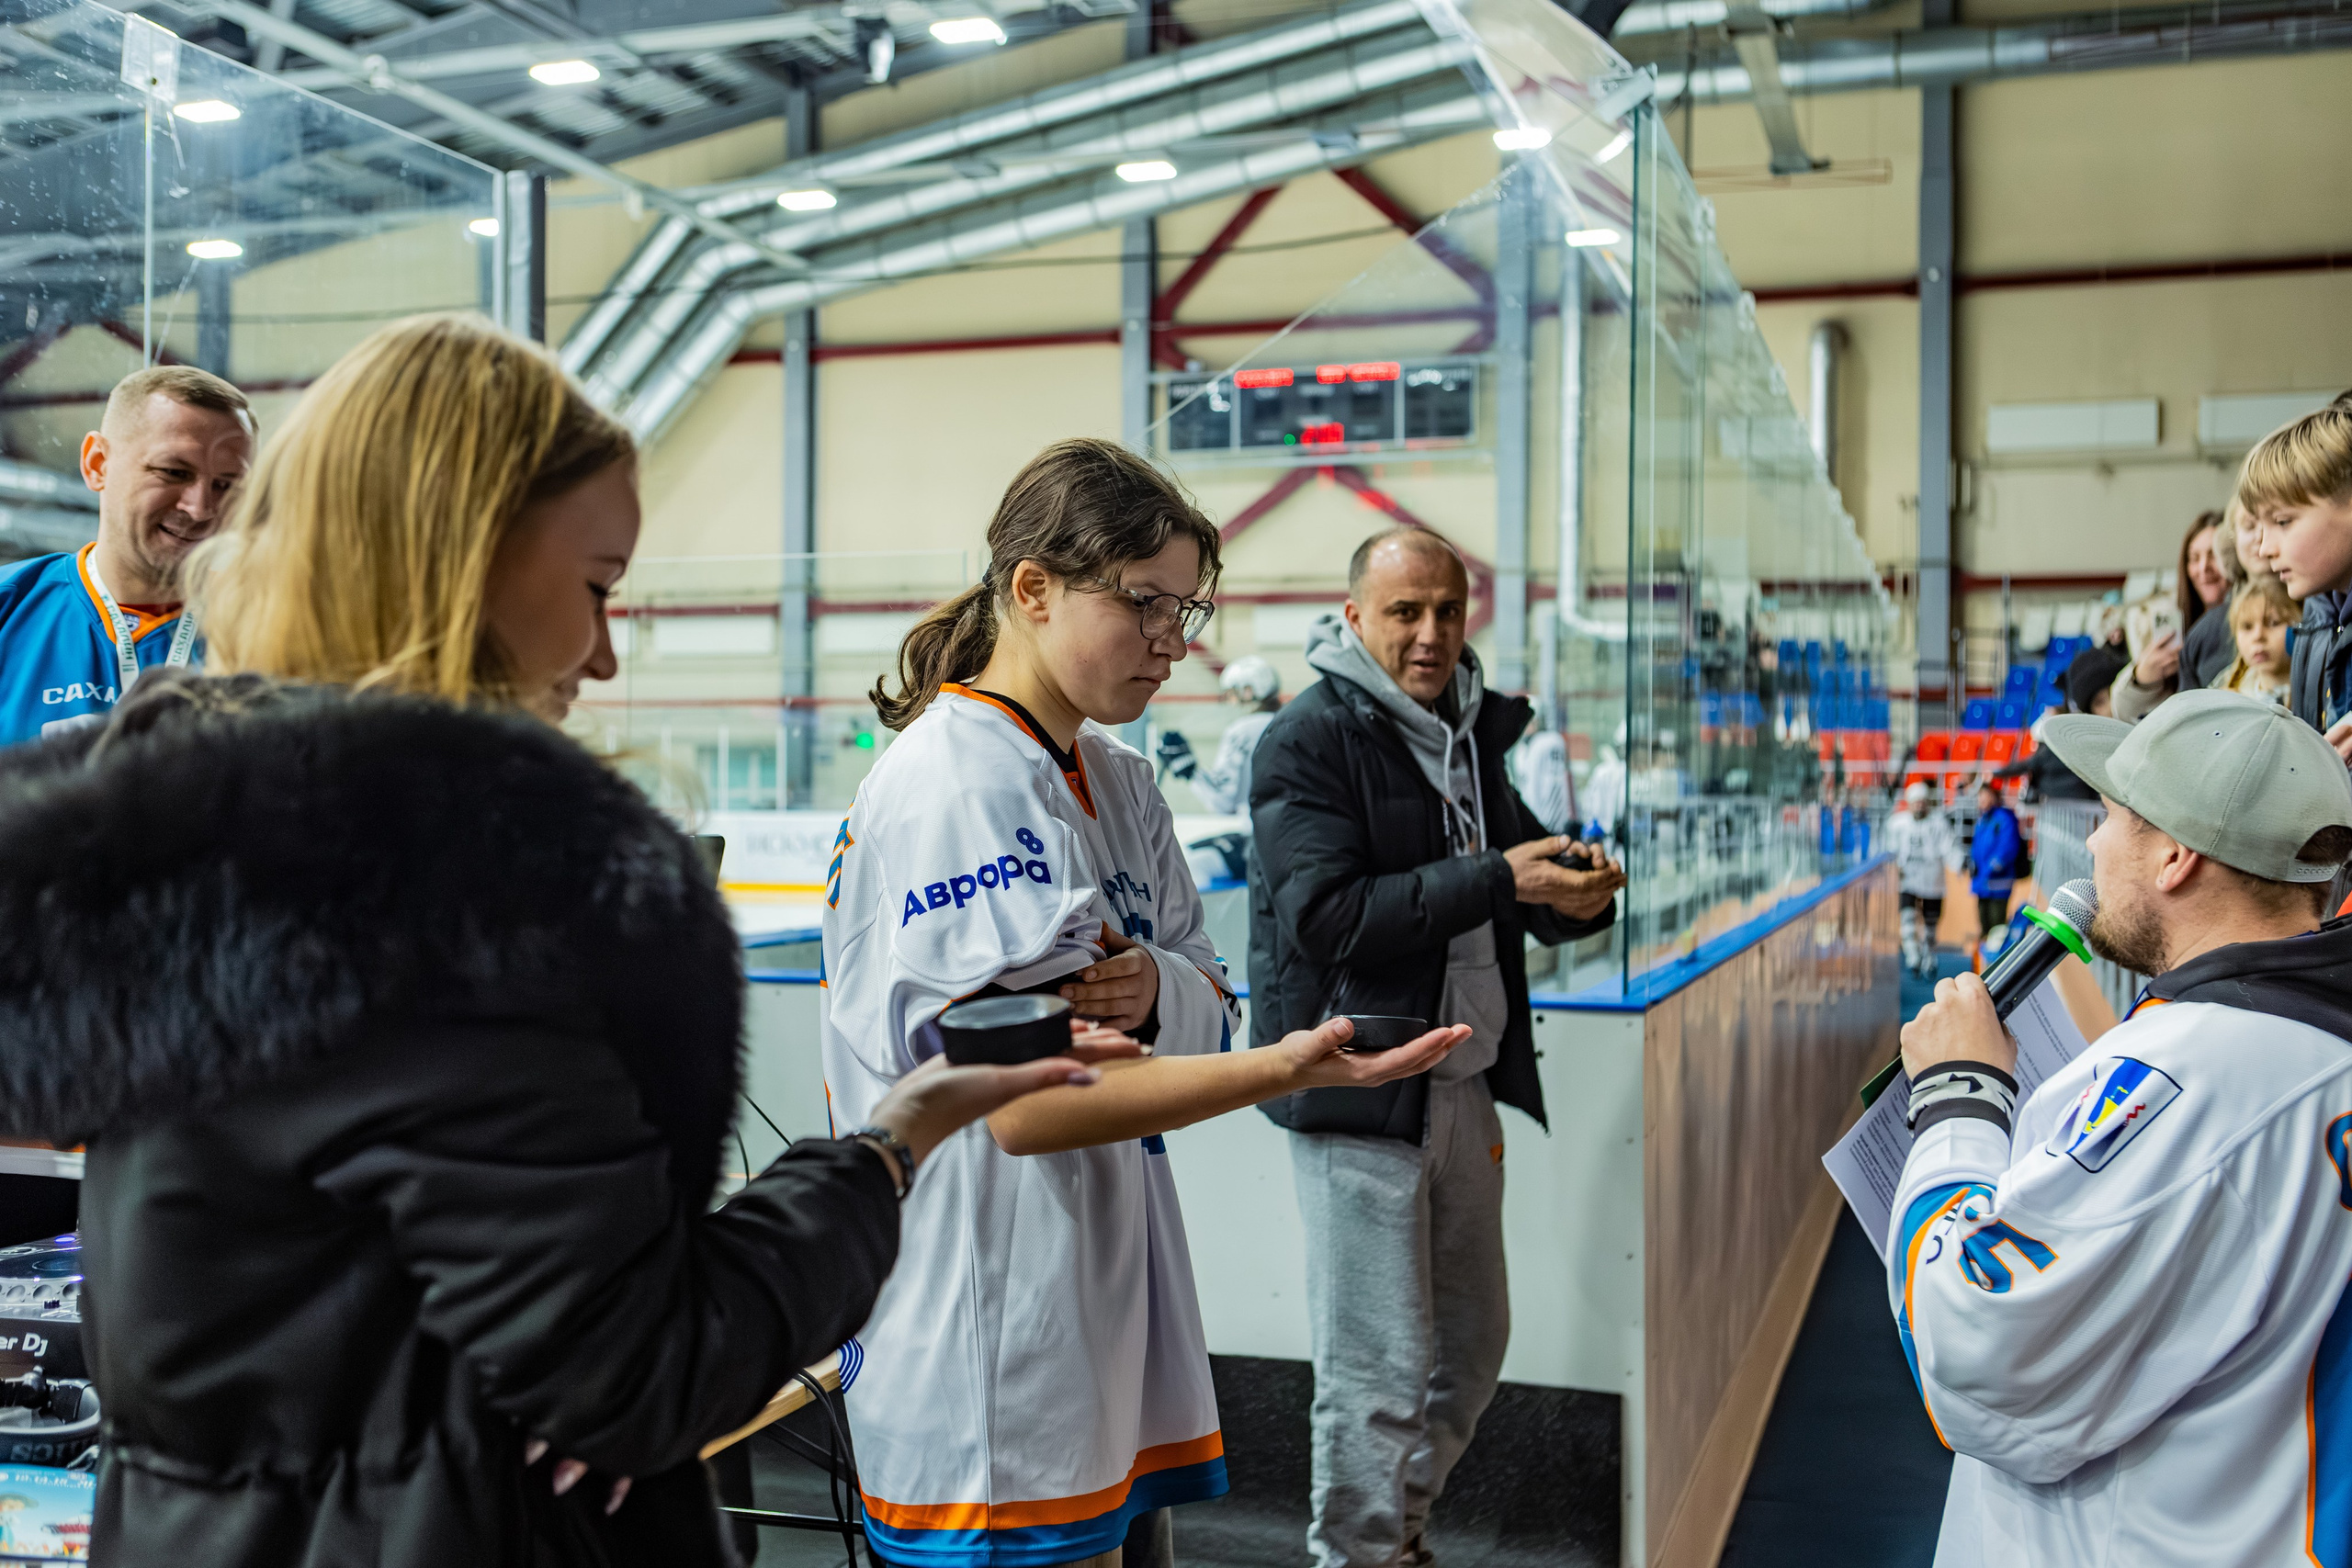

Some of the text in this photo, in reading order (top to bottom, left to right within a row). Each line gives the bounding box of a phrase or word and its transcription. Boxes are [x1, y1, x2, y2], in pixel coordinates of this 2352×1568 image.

[172, 611, 194, 662] САХАЛИ
[42, 682, 119, 705] САХА
[902, 854, 1053, 929] Аврора
